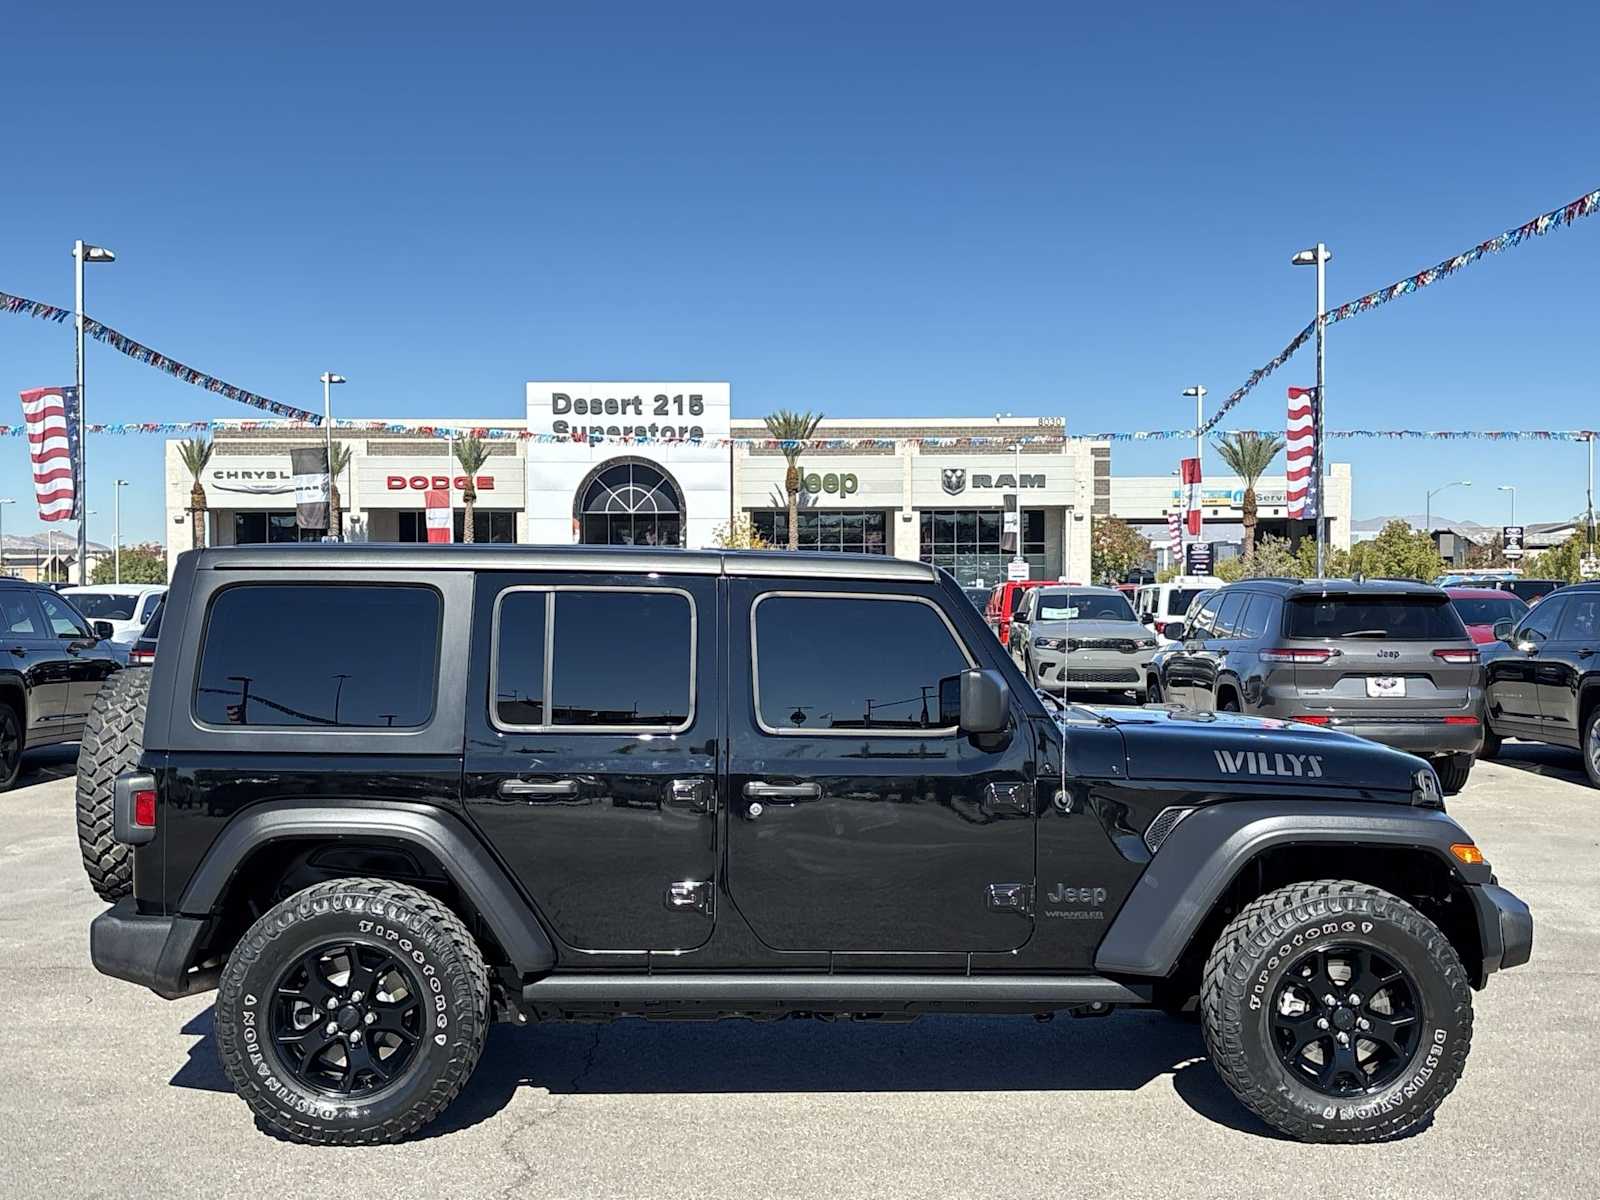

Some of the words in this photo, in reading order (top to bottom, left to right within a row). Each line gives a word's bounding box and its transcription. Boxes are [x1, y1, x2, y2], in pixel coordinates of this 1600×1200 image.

[552, 392, 643, 415] Desert
[653, 394, 704, 416] 215
[552, 420, 704, 447] Superstore
[1038, 416, 1062, 428] 8030
[213, 471, 291, 480] CHRYSL
[972, 474, 1046, 489] RAM
[1256, 493, 1286, 501] Servi
[1376, 649, 1400, 660] Jeep
[1213, 749, 1323, 778] WILLYS
[1047, 882, 1107, 907] Jeep
[359, 920, 448, 1030] Firestone
[1250, 921, 1357, 1010] Firestone
[243, 1010, 338, 1121] DESTINATION
[1339, 1029, 1448, 1120] DESTINATION
